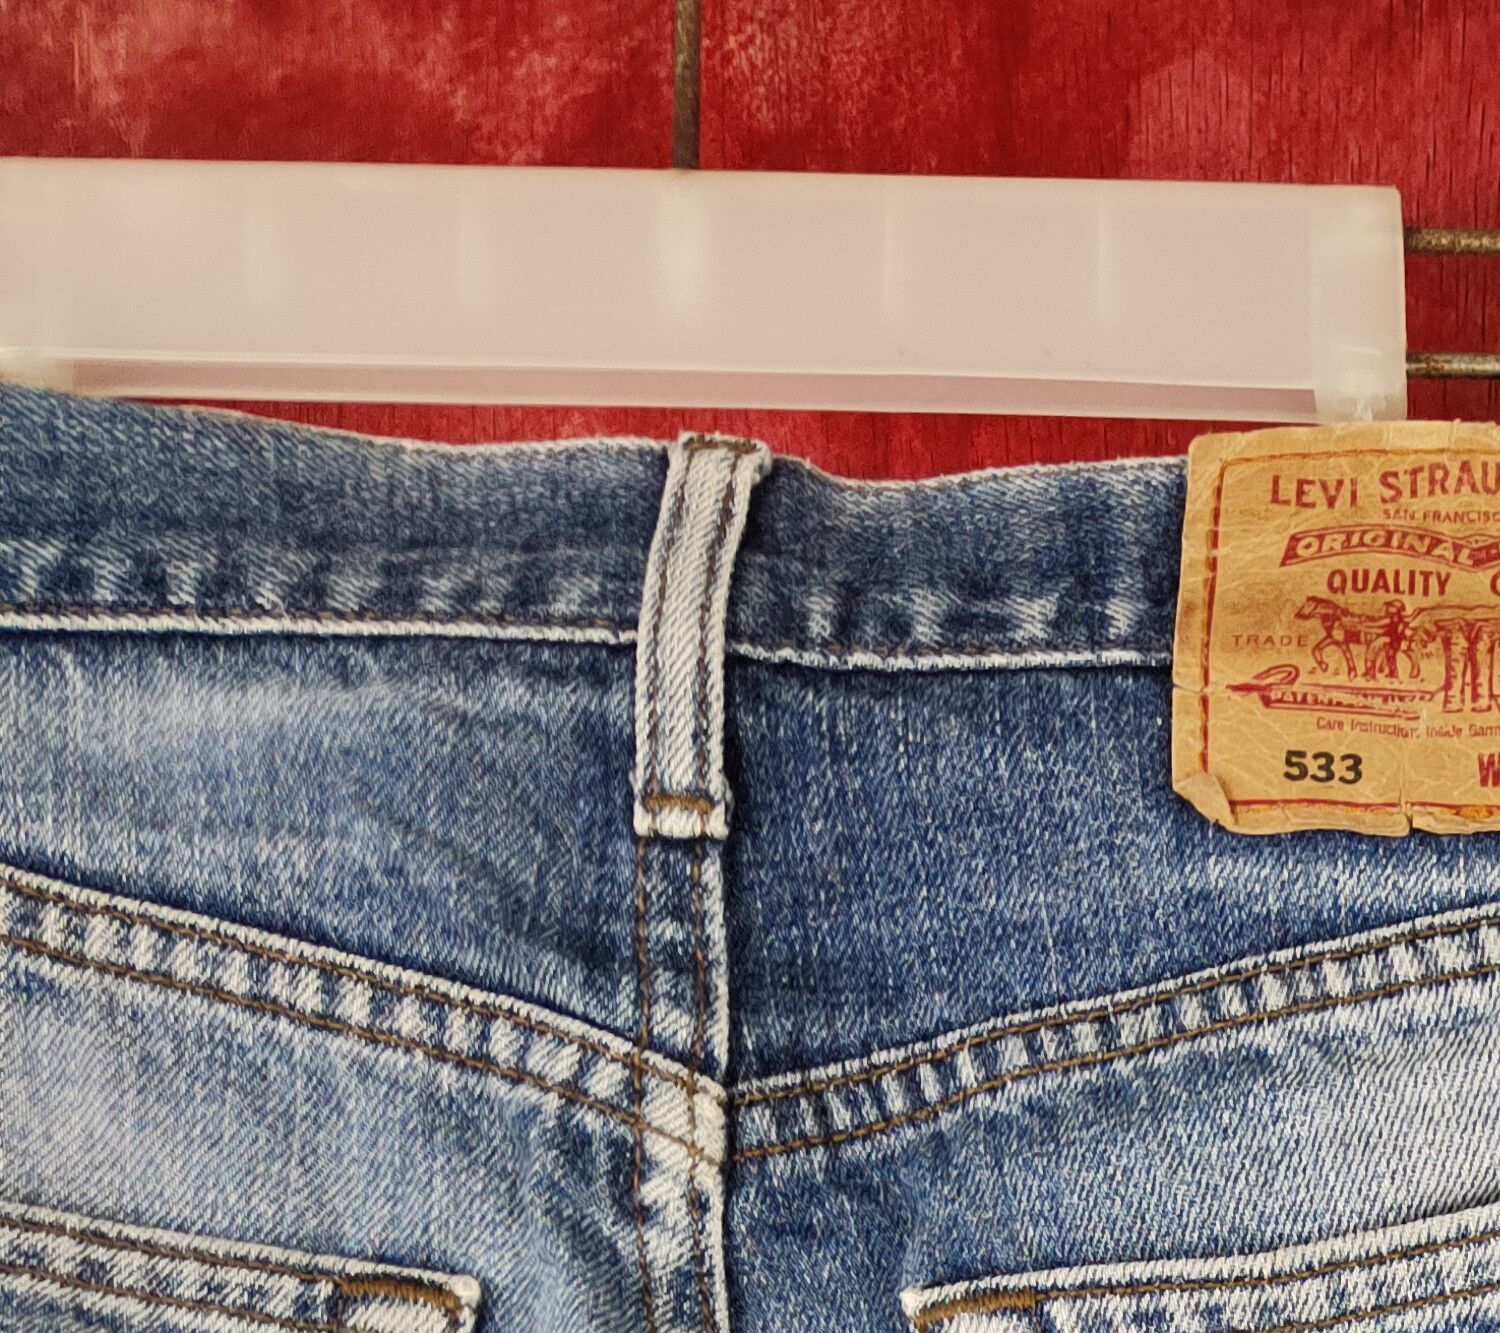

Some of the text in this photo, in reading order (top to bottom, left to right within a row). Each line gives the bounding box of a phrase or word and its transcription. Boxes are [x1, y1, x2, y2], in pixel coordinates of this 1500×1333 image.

[1269, 474, 1358, 510] LEVI
[1382, 507, 1416, 521] SAN
[1326, 568, 1452, 597] QUALITY
[1232, 634, 1309, 648] TRADE
[1316, 717, 1345, 732] Care
[1283, 750, 1363, 785] 533
